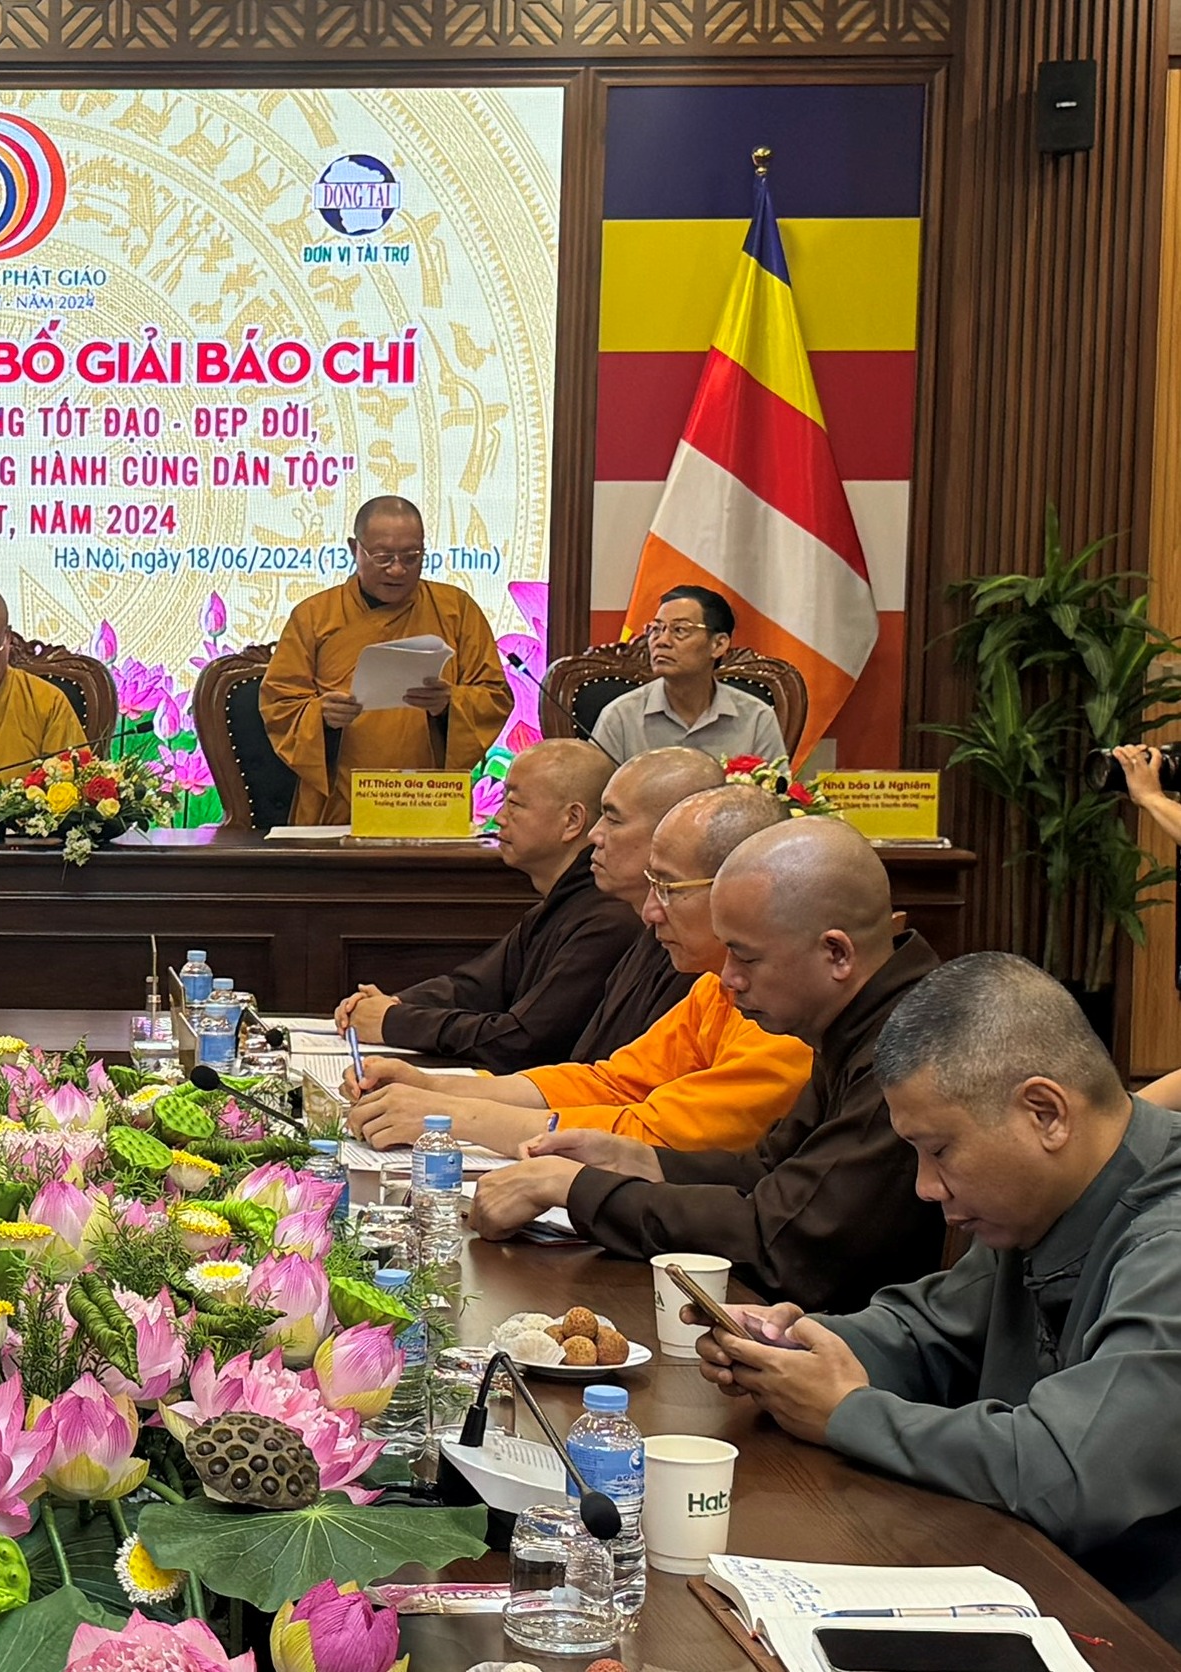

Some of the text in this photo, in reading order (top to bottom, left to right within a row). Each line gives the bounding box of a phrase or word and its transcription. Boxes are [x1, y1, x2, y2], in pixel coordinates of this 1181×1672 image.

[303, 243, 410, 266] ĐƠN VỊ TÀI TRỢ
[2, 265, 52, 290] PHẬT
[58, 265, 106, 286] GIÁO
[15, 290, 54, 309] NĂM
[58, 293, 96, 309] 2024
[76, 327, 181, 383] GIẢI
[196, 327, 311, 383] BÁO
[322, 328, 416, 383] CHÍ
[38, 396, 92, 438] TỐT
[103, 405, 160, 443] ĐẠO
[194, 405, 248, 443] ĐẸP
[261, 401, 319, 445] ĐỜI,
[30, 450, 107, 486] HÀNH
[121, 450, 199, 486] CÙNG
[213, 450, 270, 486] DÂN
[286, 449, 356, 491] TỘC"
[30, 500, 92, 535] NĂM
[107, 505, 176, 535] 2024
[54, 547, 80, 569] Hà
[85, 547, 126, 574] Nội,
[130, 548, 181, 576] ngày
[187, 547, 312, 571] 18/06/2024
[449, 546, 501, 575] Thìn)
[404, 779, 423, 789] Gia
[427, 779, 463, 791] Quang
[823, 781, 845, 790] Nhà
[848, 780, 870, 790] báo
